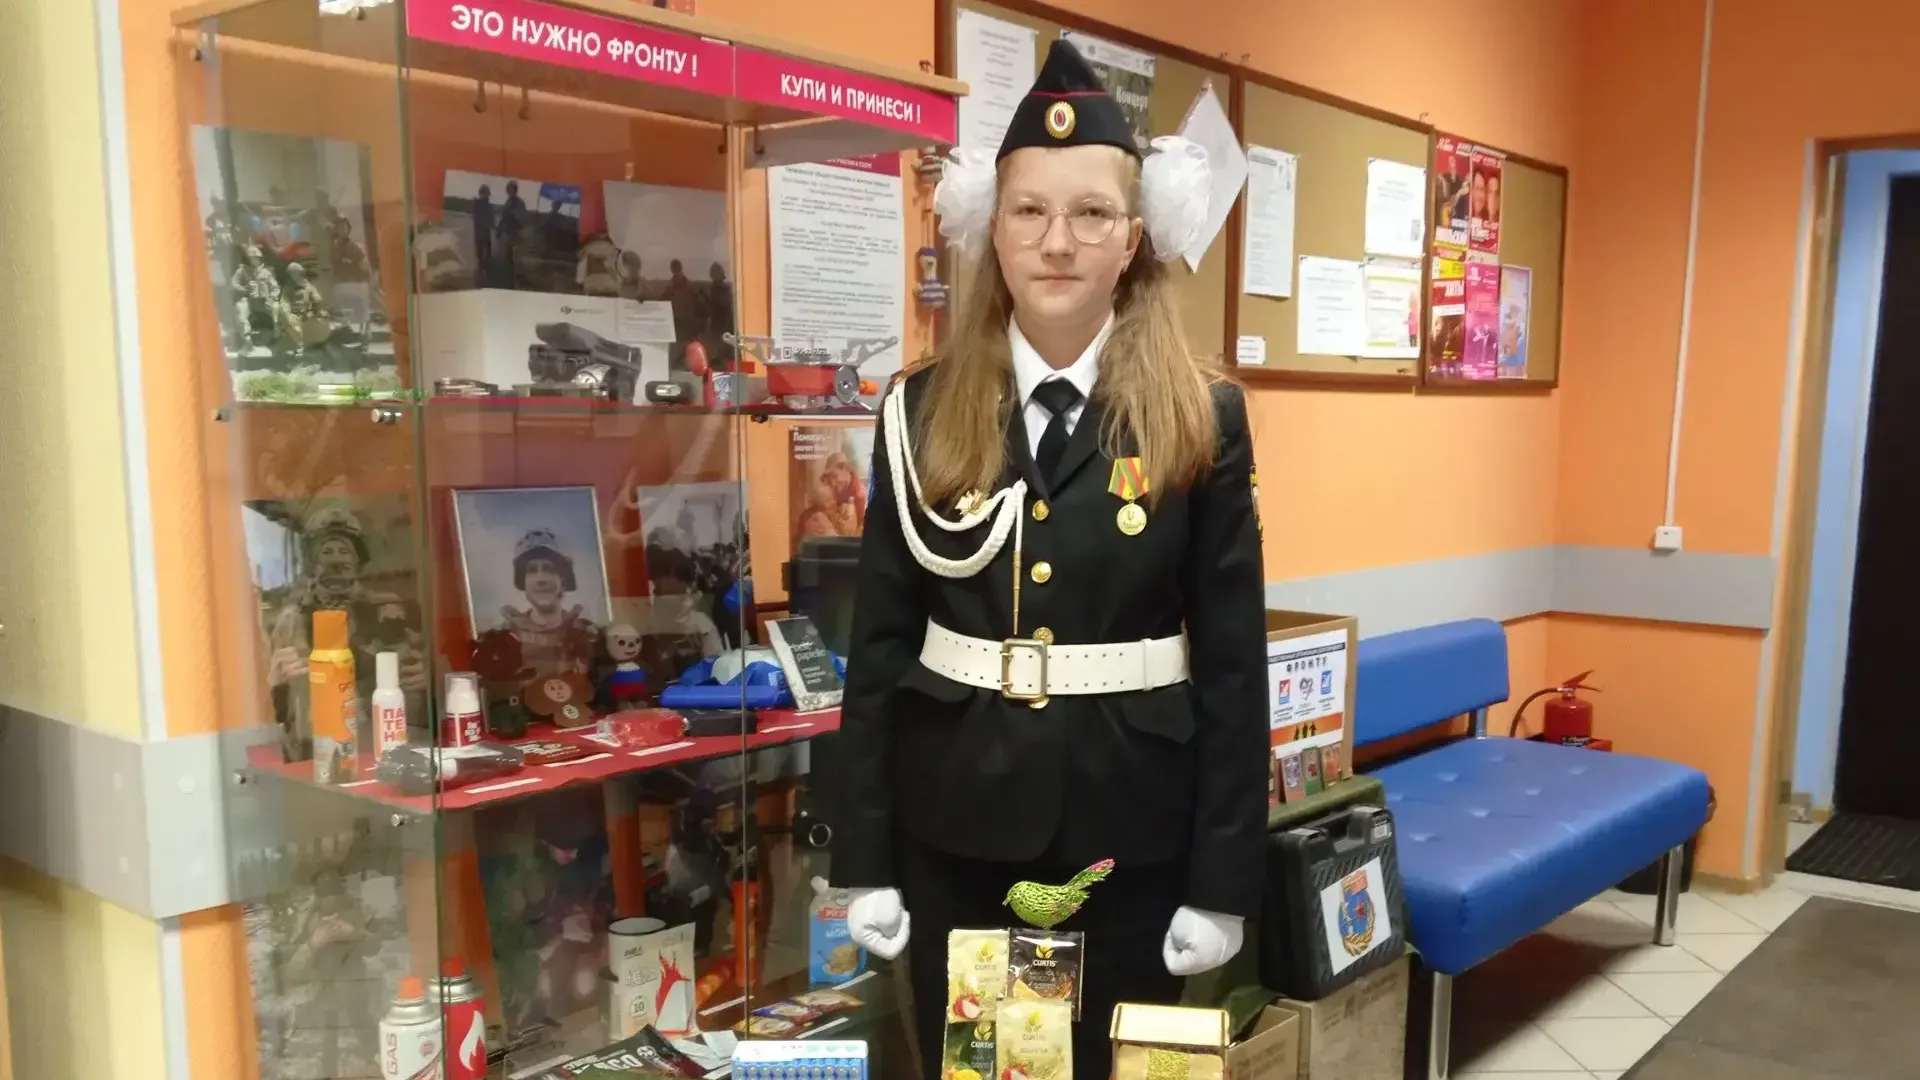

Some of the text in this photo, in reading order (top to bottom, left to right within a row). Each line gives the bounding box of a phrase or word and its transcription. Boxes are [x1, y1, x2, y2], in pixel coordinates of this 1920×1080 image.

[451, 5, 504, 37] ЭТО
[512, 16, 601, 57] НУЖНО
[606, 37, 687, 74] ФРОНТУ
[780, 73, 826, 103] КУПИ
[831, 84, 842, 106] И
[846, 87, 914, 123] ПРИНЕСИ
[387, 1033, 398, 1075] GAS
[970, 1041, 994, 1049] CURTIS
